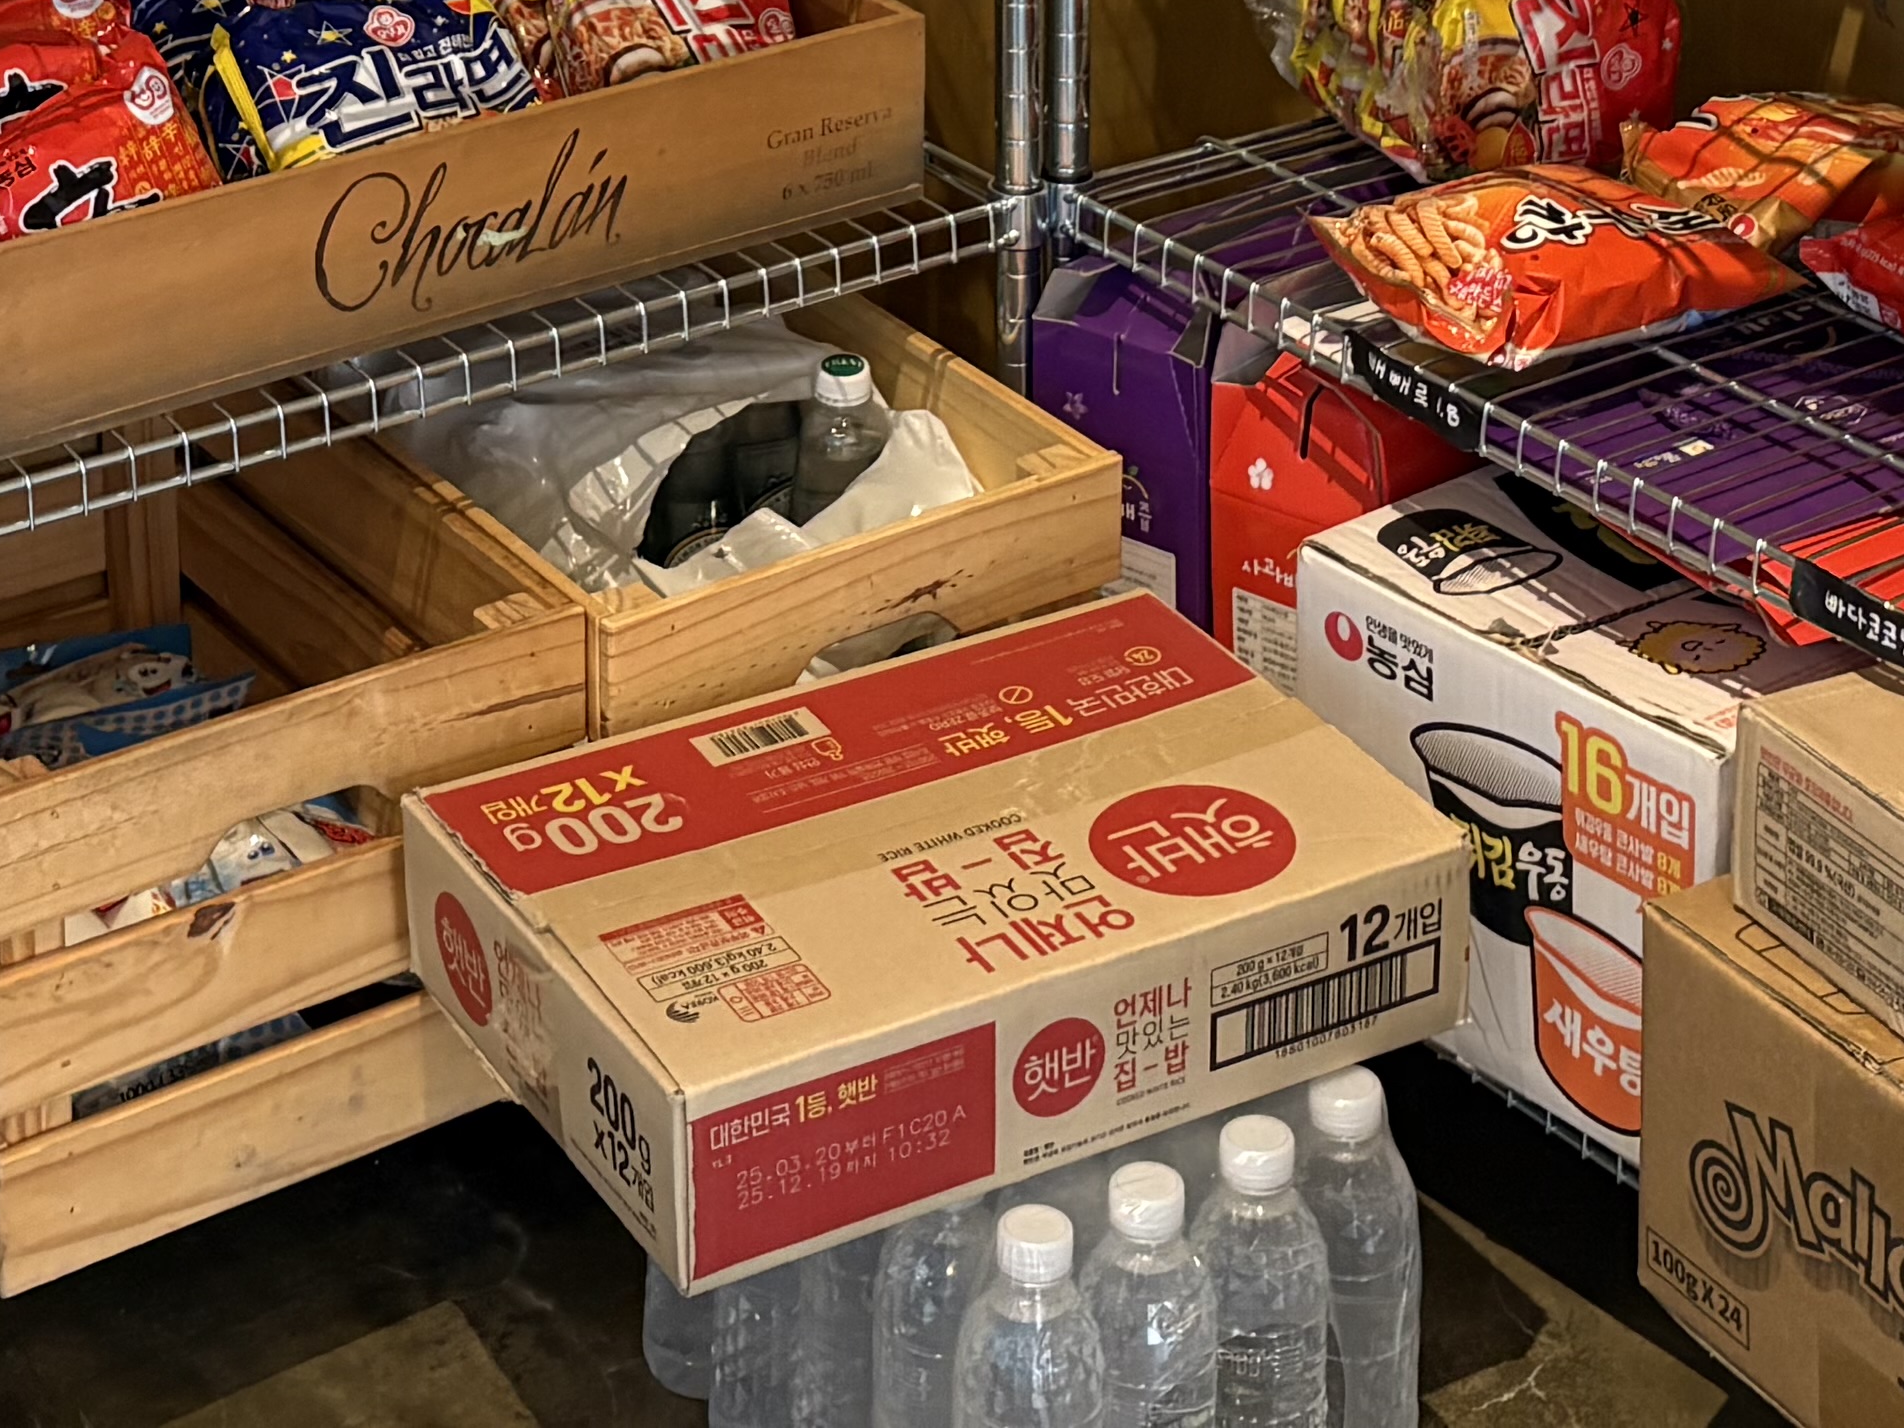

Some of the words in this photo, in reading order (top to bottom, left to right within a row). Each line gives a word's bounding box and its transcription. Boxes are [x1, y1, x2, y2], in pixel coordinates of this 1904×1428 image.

[292, 22, 533, 152] 진라면
[767, 126, 814, 149] Gran
[819, 107, 893, 136] Reserva
[782, 182, 793, 200] 6
[799, 183, 810, 195] x
[813, 169, 845, 194] 750
[850, 160, 874, 183] ml
[1436, 394, 1460, 428] 1.8
[1365, 615, 1398, 645] 인생을
[1399, 632, 1434, 664] 맛있게
[1067, 662, 1197, 717] 대한민국
[1365, 634, 1434, 702] 농심
[942, 712, 1008, 758] 햇반
[1003, 699, 1074, 748] 1등,
[1560, 719, 1692, 851] 16개입
[502, 792, 686, 856] 200g
[915, 826, 960, 851] WHITE
[963, 811, 1023, 836] COOKED
[995, 826, 1063, 871] 집
[1118, 800, 1276, 879] 햇반
[876, 842, 912, 863] RICE
[1616, 825, 1655, 866] 큰사발
[1656, 849, 1682, 880] 8개
[1616, 854, 1655, 892] 큰사발
[891, 861, 937, 901] 밥
[920, 860, 1098, 925] 맛있는
[954, 890, 1137, 974] 언제나
[1340, 897, 1443, 964] 12개입
[440, 915, 488, 1009] 햇반
[673, 992, 719, 1012] KOREA
[1113, 976, 1193, 1031] 언제나
[1115, 1014, 1190, 1060] 맛있는
[1024, 1036, 1097, 1103] 햇반
[1114, 1058, 1137, 1093] 집
[1164, 1043, 1188, 1075] 밥
[586, 1056, 652, 1176] 200g
[709, 1102, 791, 1151] 대한민국
[794, 1093, 833, 1125] 1등,
[835, 1076, 879, 1112] 햇반
[888, 1129, 952, 1165] 10:32
